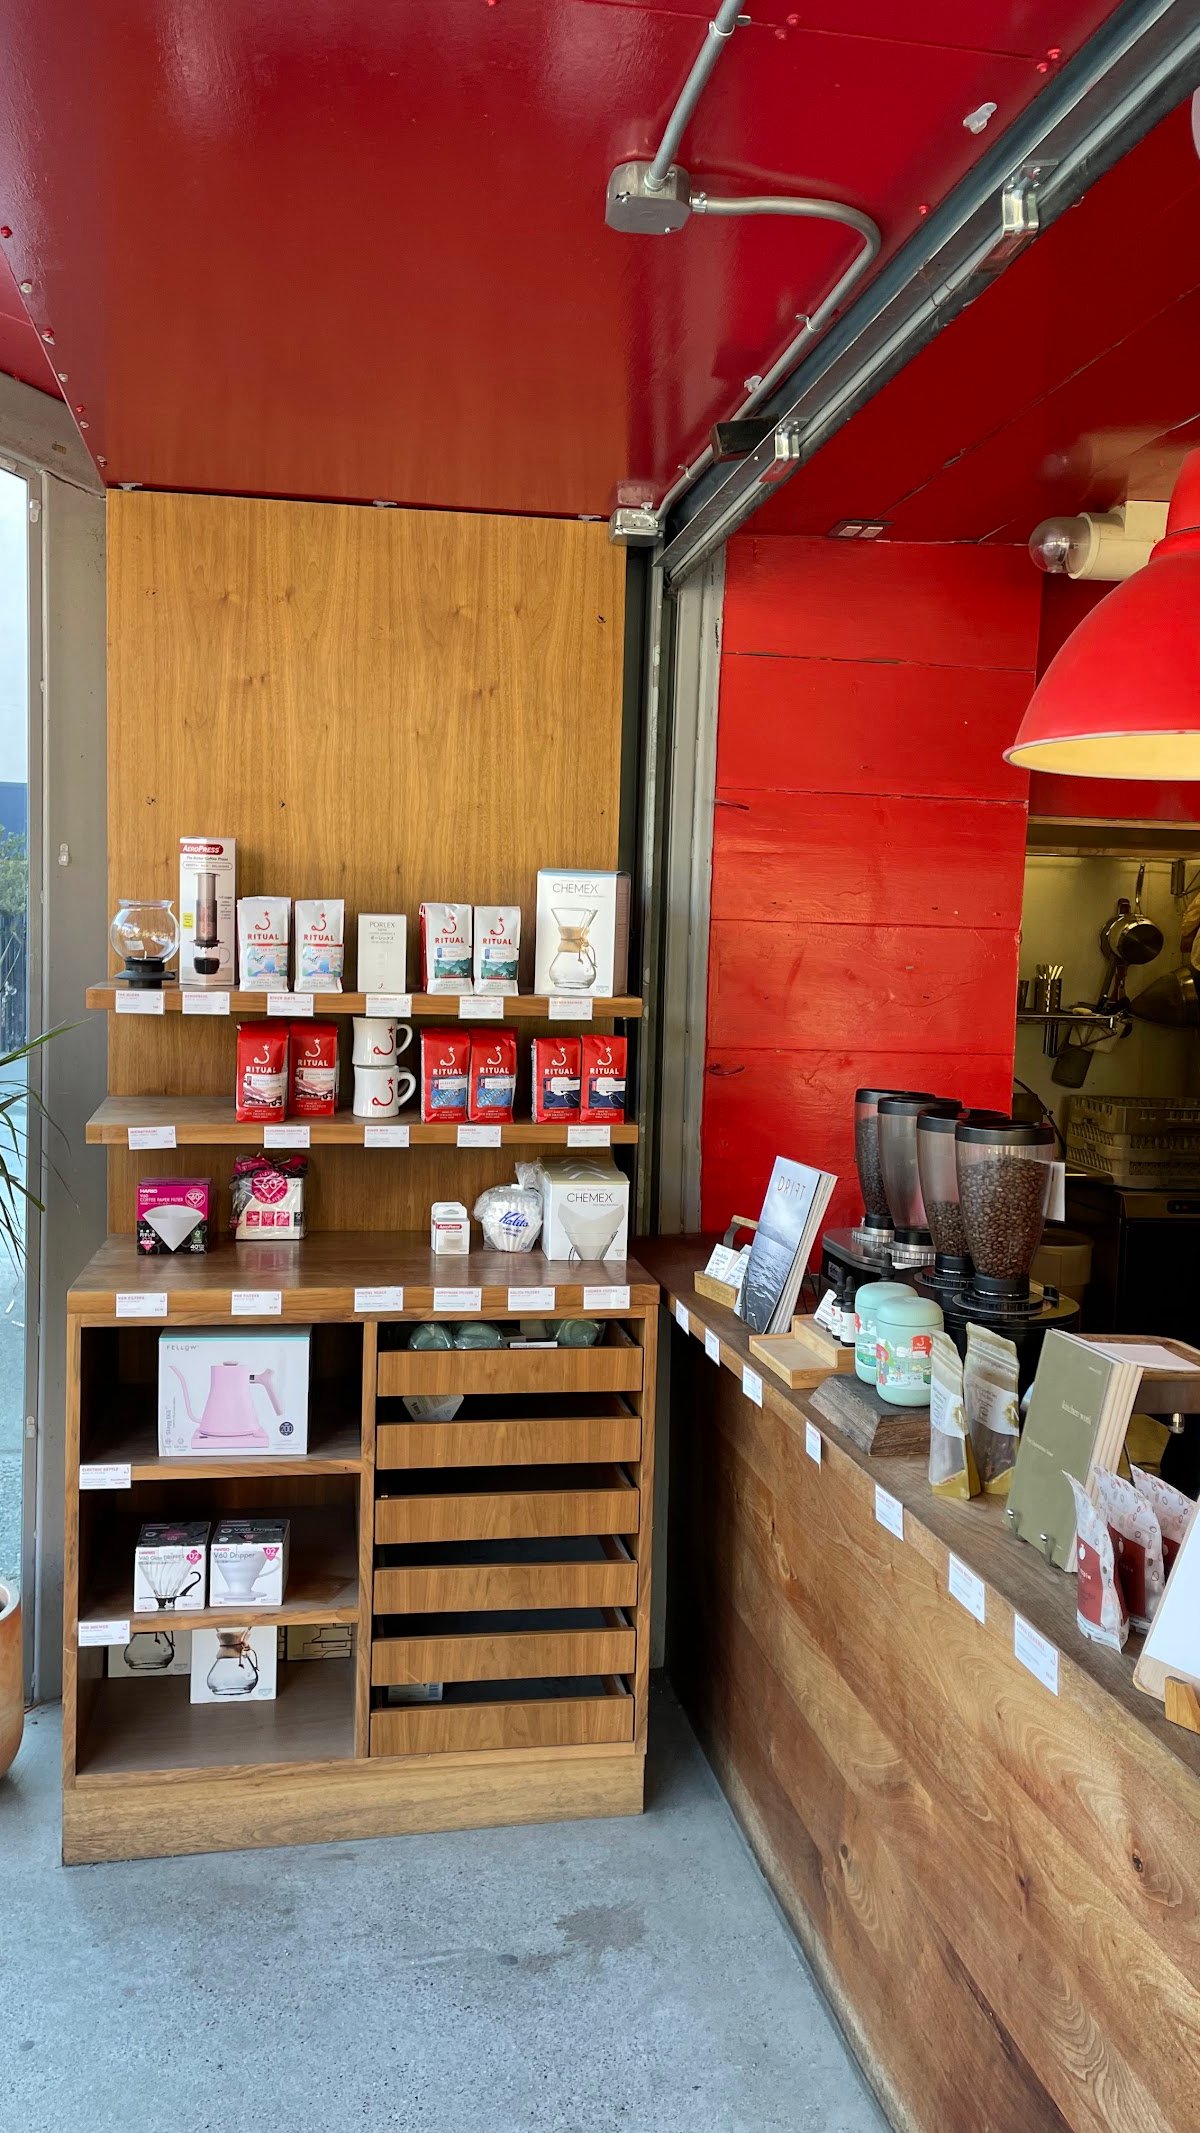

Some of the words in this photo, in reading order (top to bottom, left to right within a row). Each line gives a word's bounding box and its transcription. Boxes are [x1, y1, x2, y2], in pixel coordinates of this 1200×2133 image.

[552, 883, 598, 894] CHEMEX
[567, 1193, 613, 1202] CHEMEX
[499, 1211, 529, 1227] Kalita
[230, 1552, 255, 1560] Dripper
